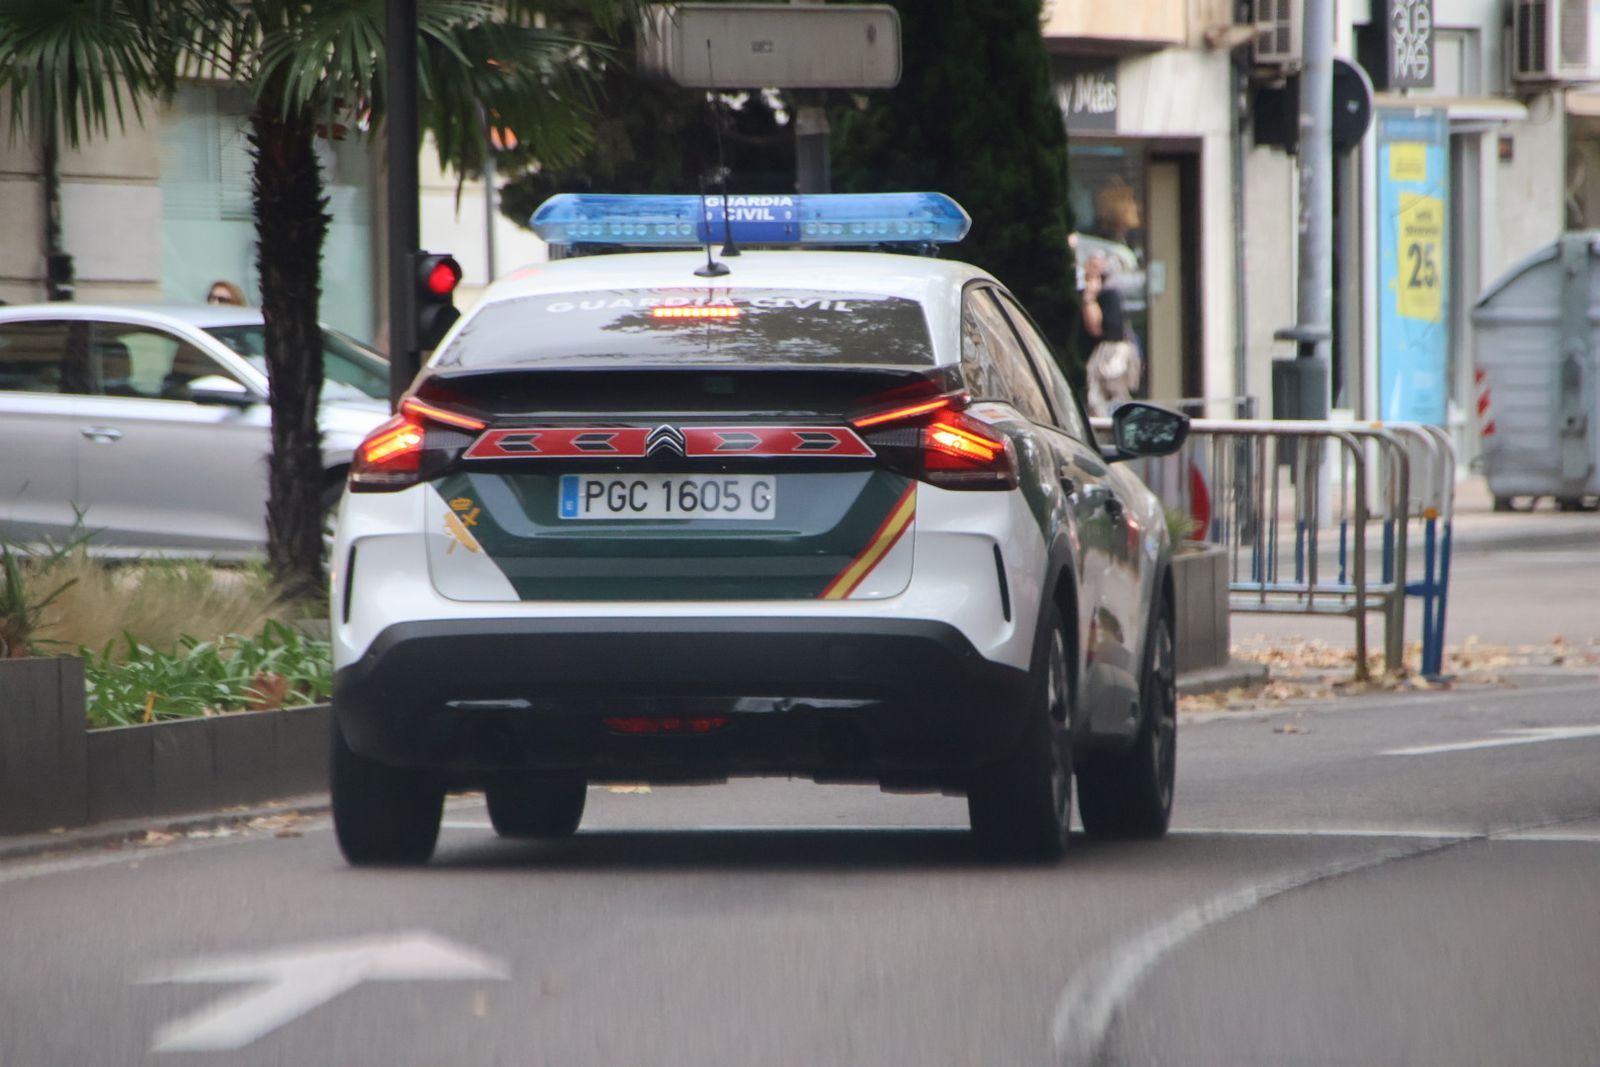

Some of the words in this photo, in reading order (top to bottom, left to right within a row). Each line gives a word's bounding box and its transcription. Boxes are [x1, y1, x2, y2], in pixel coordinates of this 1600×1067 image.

[705, 197, 793, 207] GUARDIA
[722, 208, 775, 221] CIVIL
[546, 296, 735, 313] GUARDIA
[751, 296, 853, 312] CIVIL
[585, 480, 648, 512] PGC
[661, 480, 741, 512] 1605
[750, 480, 771, 512] G
